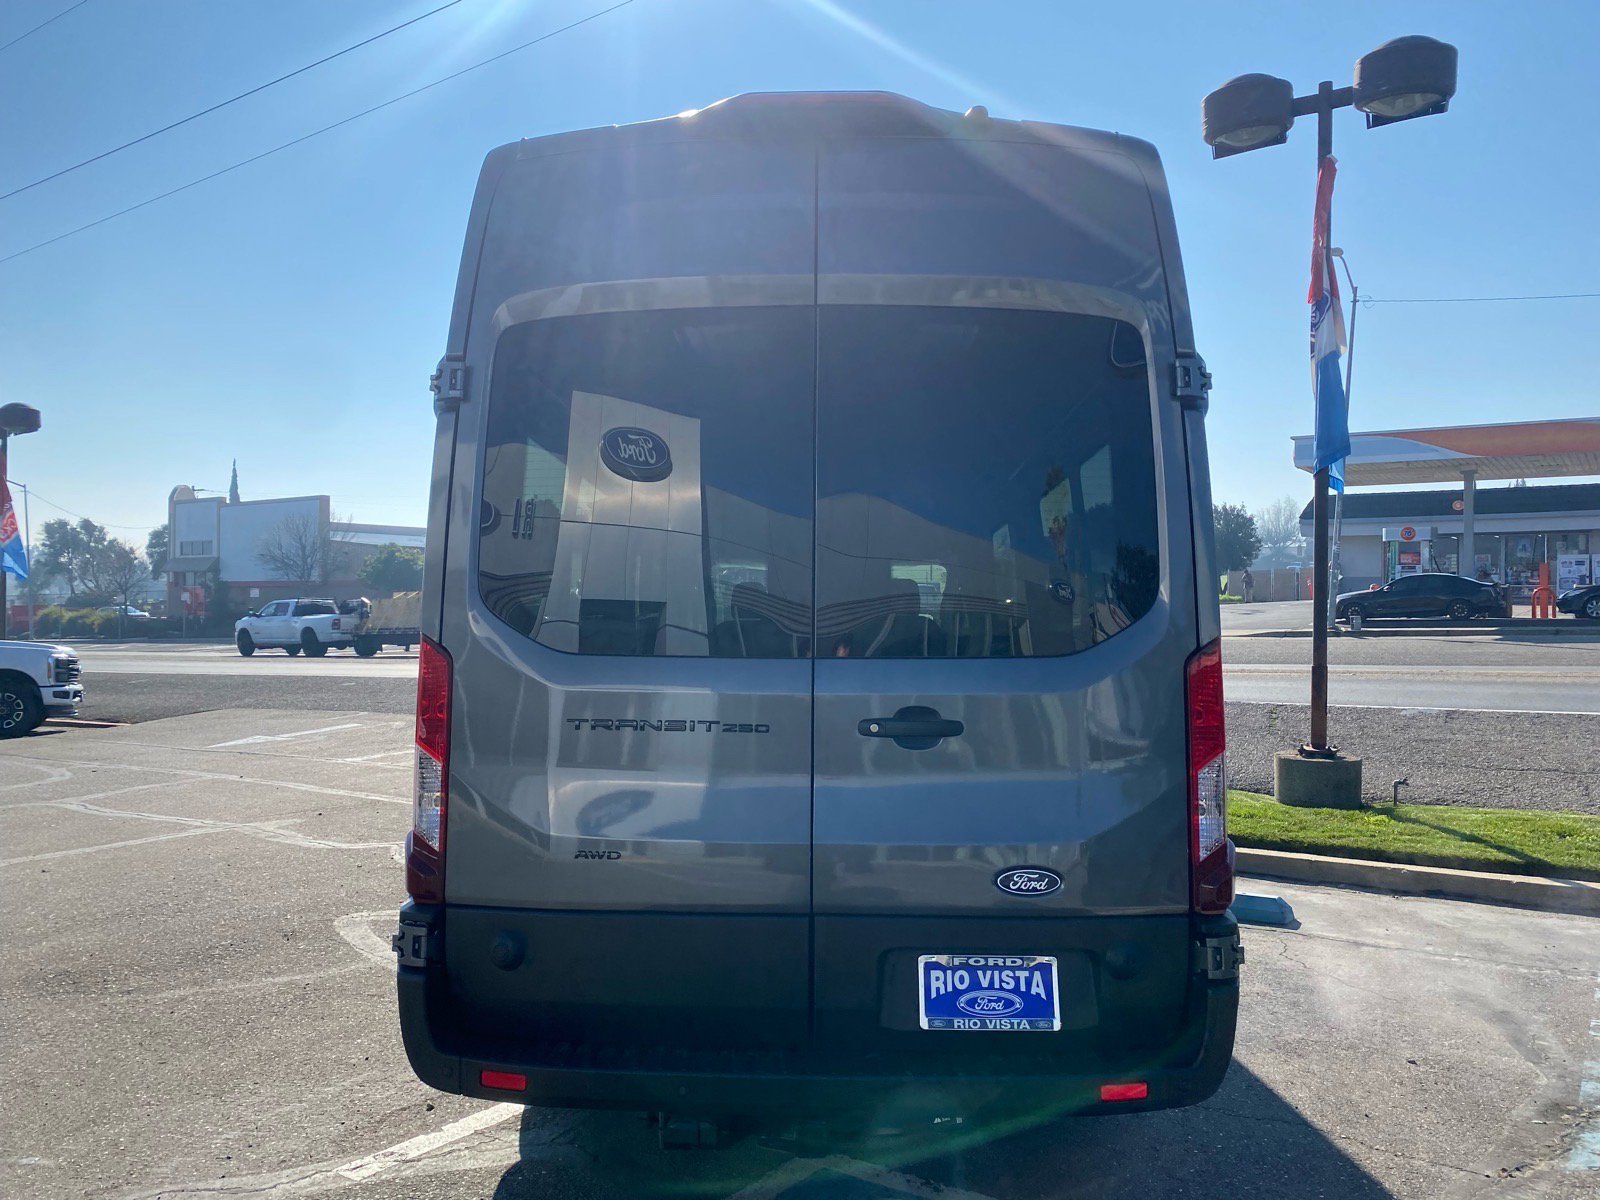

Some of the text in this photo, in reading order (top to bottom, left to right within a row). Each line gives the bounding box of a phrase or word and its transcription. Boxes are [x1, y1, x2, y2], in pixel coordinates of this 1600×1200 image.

[566, 718, 770, 733] TRANSIT 250
[574, 850, 622, 860] AWD
[1009, 873, 1049, 890] Ford
[953, 957, 1023, 967] FORD
[930, 969, 1047, 1001] RIO VISTA
[974, 996, 1005, 1010] Ford
[953, 1019, 981, 1029] RIO
[985, 1019, 1031, 1030] VISTA
